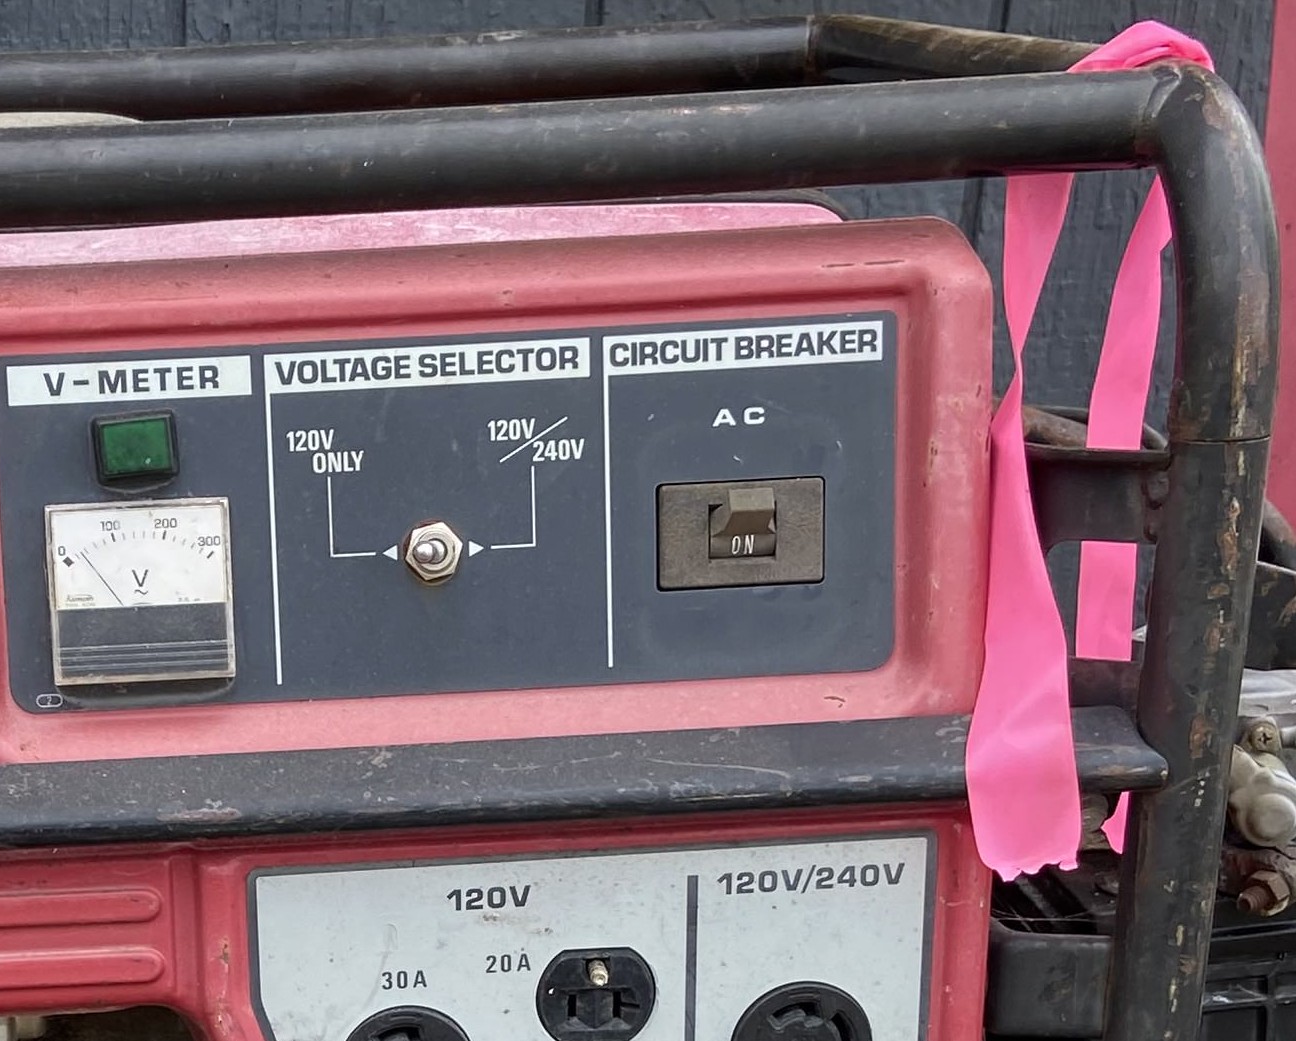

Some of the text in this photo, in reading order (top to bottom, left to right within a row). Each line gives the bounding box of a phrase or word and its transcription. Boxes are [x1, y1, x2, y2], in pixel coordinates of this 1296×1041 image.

[609, 329, 878, 367] CIRCUIT BREAKER
[275, 346, 579, 386] VOLTAGE SELECTOR
[43, 365, 220, 396] V-METER
[712, 407, 765, 427] AC
[286, 429, 334, 452] 120V
[487, 418, 535, 441] 120V
[312, 450, 364, 473] ONLY
[533, 439, 585, 462] 240V
[100, 520, 121, 531] 100
[154, 518, 177, 529] 200
[197, 535, 221, 547] 300
[731, 535, 754, 555] ON
[132, 569, 148, 587] V
[716, 862, 906, 896] 120V/240V
[446, 885, 532, 912] 120V
